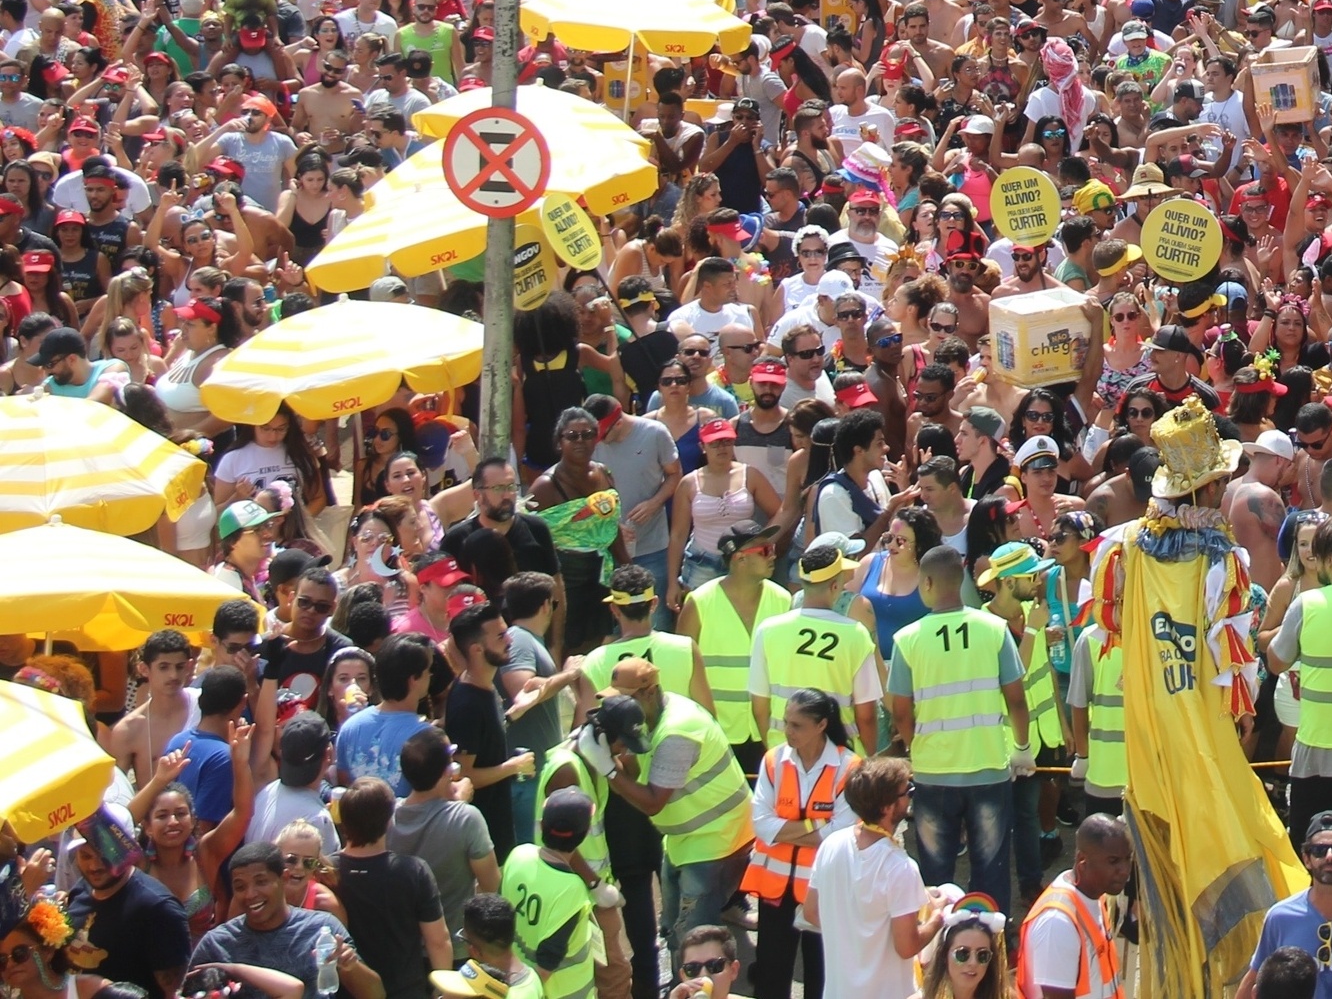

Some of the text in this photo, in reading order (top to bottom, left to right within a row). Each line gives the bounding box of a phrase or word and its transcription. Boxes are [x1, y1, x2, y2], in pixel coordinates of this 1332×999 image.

[665, 44, 687, 54] SKOL
[1001, 178, 1039, 193] QUER UM
[612, 192, 630, 205] SKOL
[1005, 189, 1041, 207] ALÍVIO?
[547, 202, 573, 221] QUER UM
[1017, 208, 1030, 216] QUEM
[1031, 206, 1044, 214] SABE
[1164, 210, 1208, 228] QUER UM
[1009, 213, 1047, 231] CURTIR
[1161, 220, 1205, 242] ALÍVIO?
[566, 234, 594, 257] CURTIR
[1159, 236, 1202, 253] PRA QUEM SABE
[430, 250, 458, 266] SKOL
[514, 244, 539, 264] NGOV
[1155, 244, 1200, 267] CURTIR
[514, 269, 547, 296] CURTIR
[1050, 330, 1069, 344] NÃO
[1031, 341, 1070, 356] cheg
[332, 397, 363, 412] SKOL
[259, 466, 280, 475] KINGS
[164, 613, 195, 627] SKOL
[796, 628, 839, 661] 22
[936, 622, 969, 652] 11
[47, 803, 76, 830] SKOL
[515, 883, 542, 926] 20
